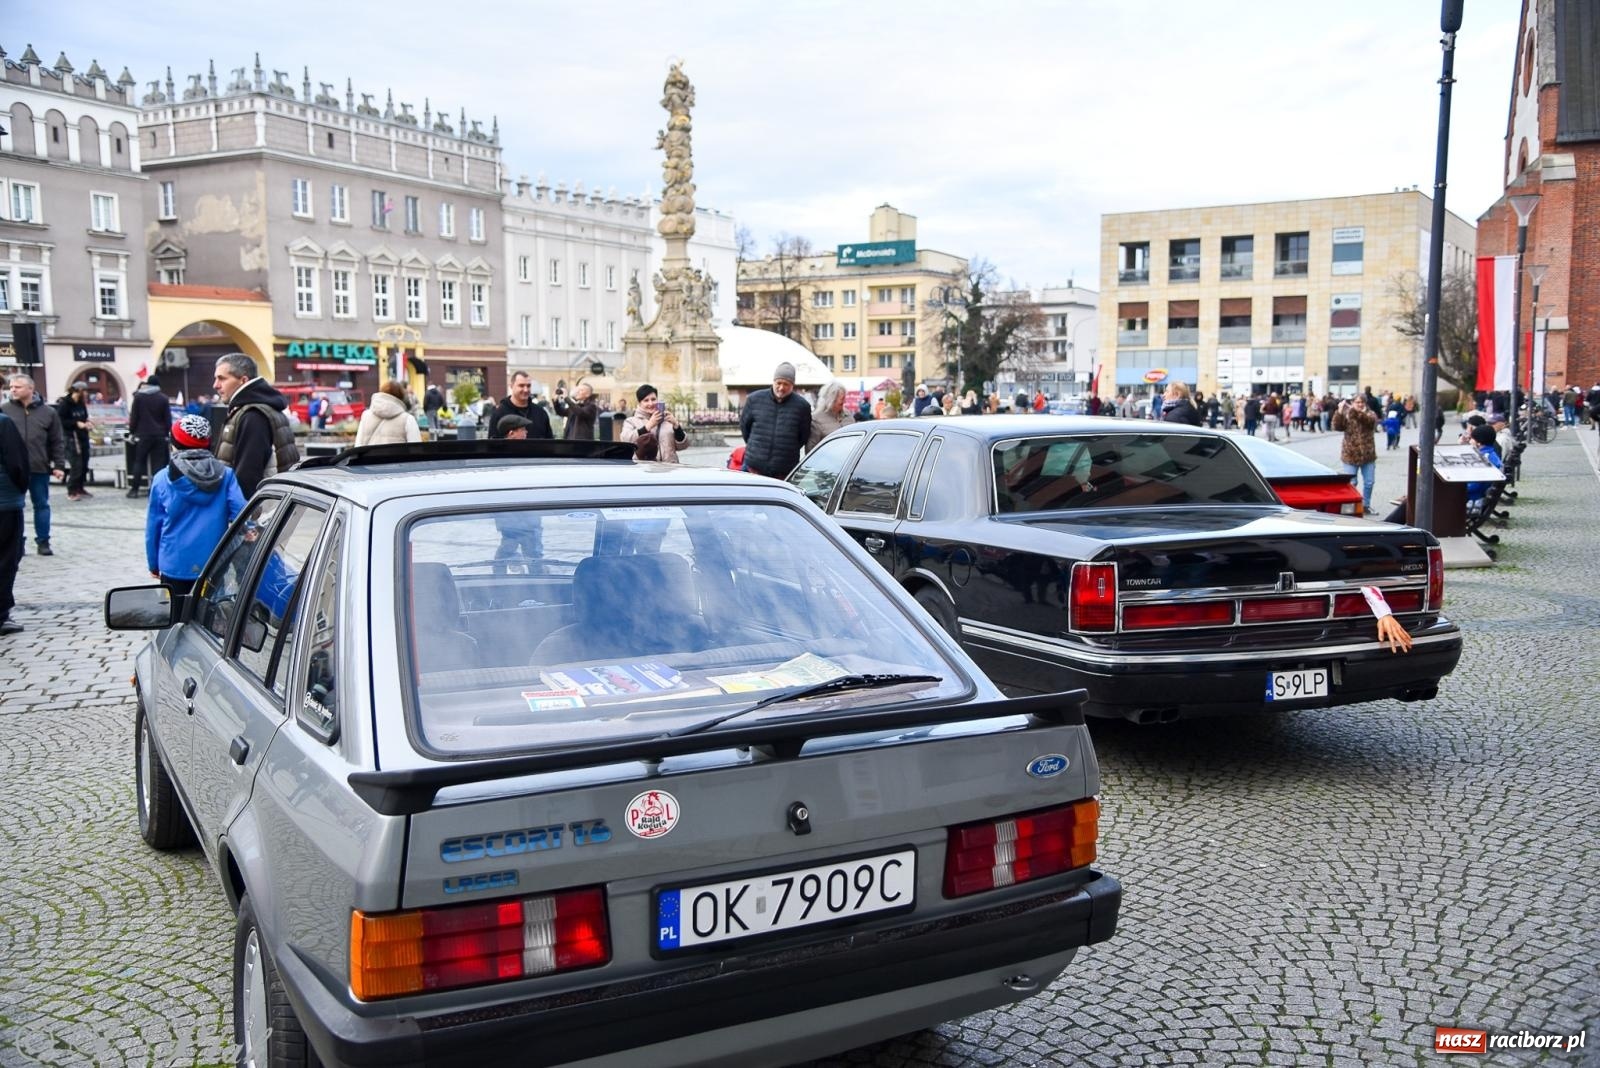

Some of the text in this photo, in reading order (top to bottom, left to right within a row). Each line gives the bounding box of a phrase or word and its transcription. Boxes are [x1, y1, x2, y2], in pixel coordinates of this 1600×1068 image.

[286, 341, 376, 359] APTEKA
[1126, 577, 1162, 586] TOWN CAR
[1274, 672, 1325, 697] S 9LP
[1037, 758, 1060, 773] Ford
[440, 823, 566, 864] ESCORT
[443, 869, 519, 894] LASER
[692, 858, 903, 938] OK 7909C
[660, 926, 678, 942] PL
